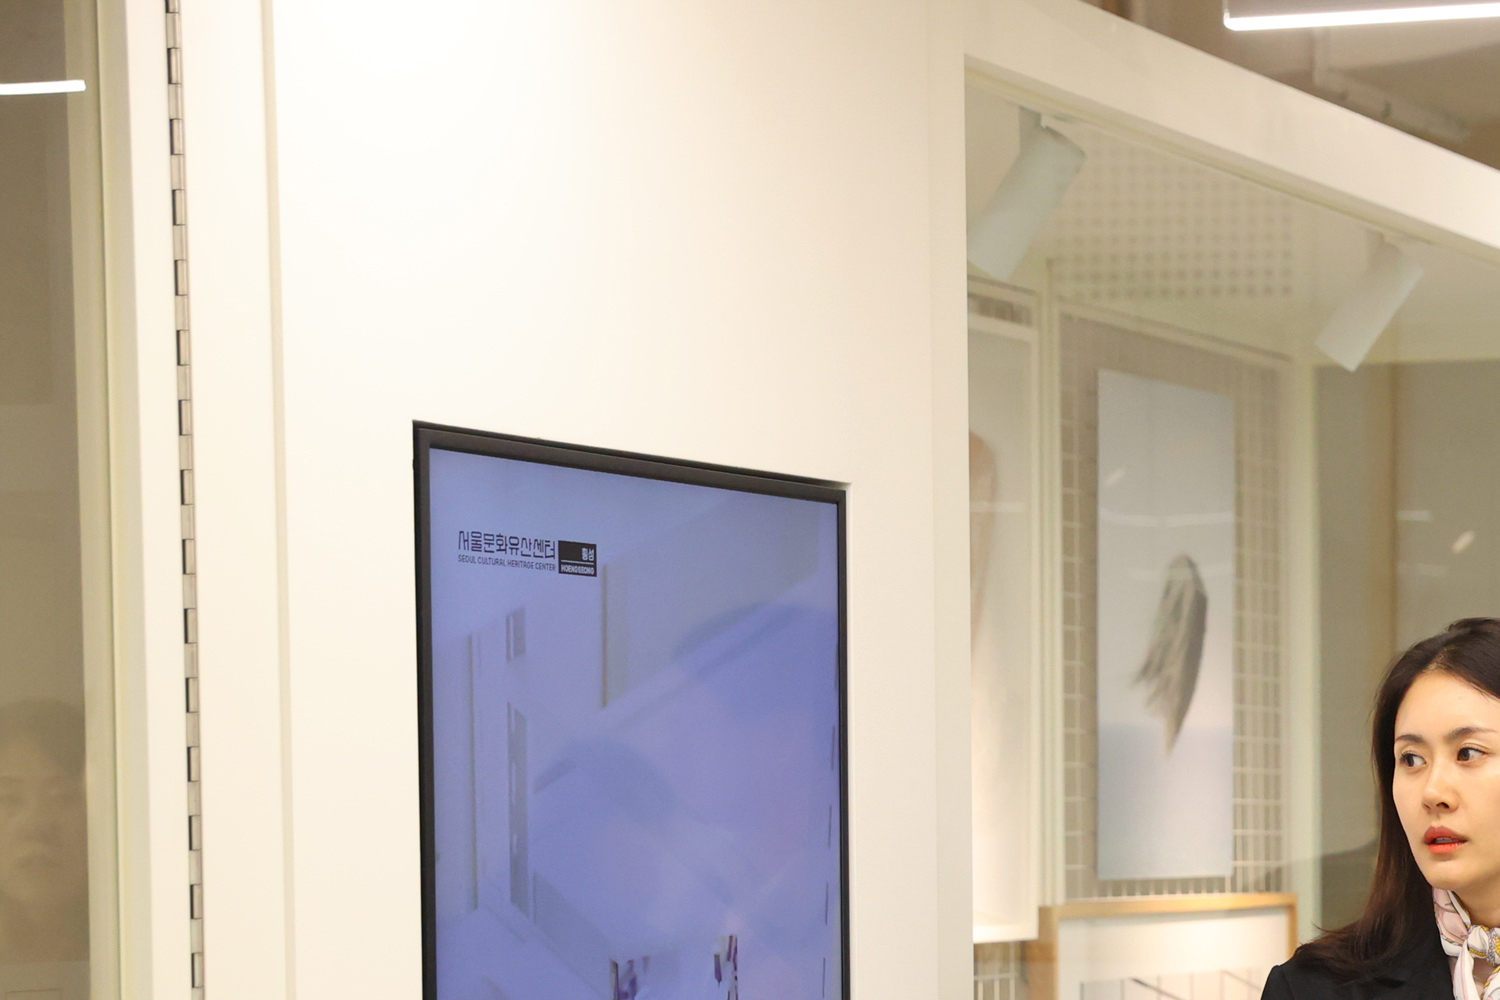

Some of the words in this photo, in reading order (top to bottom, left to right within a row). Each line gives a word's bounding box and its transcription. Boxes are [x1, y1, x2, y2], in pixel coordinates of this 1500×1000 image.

[458, 530, 556, 559] 서울문화유산센터
[458, 554, 477, 564] SEOUL
[477, 556, 507, 567] CULTURAL
[507, 559, 534, 569] HERITAGE
[534, 562, 556, 572] CENTER
